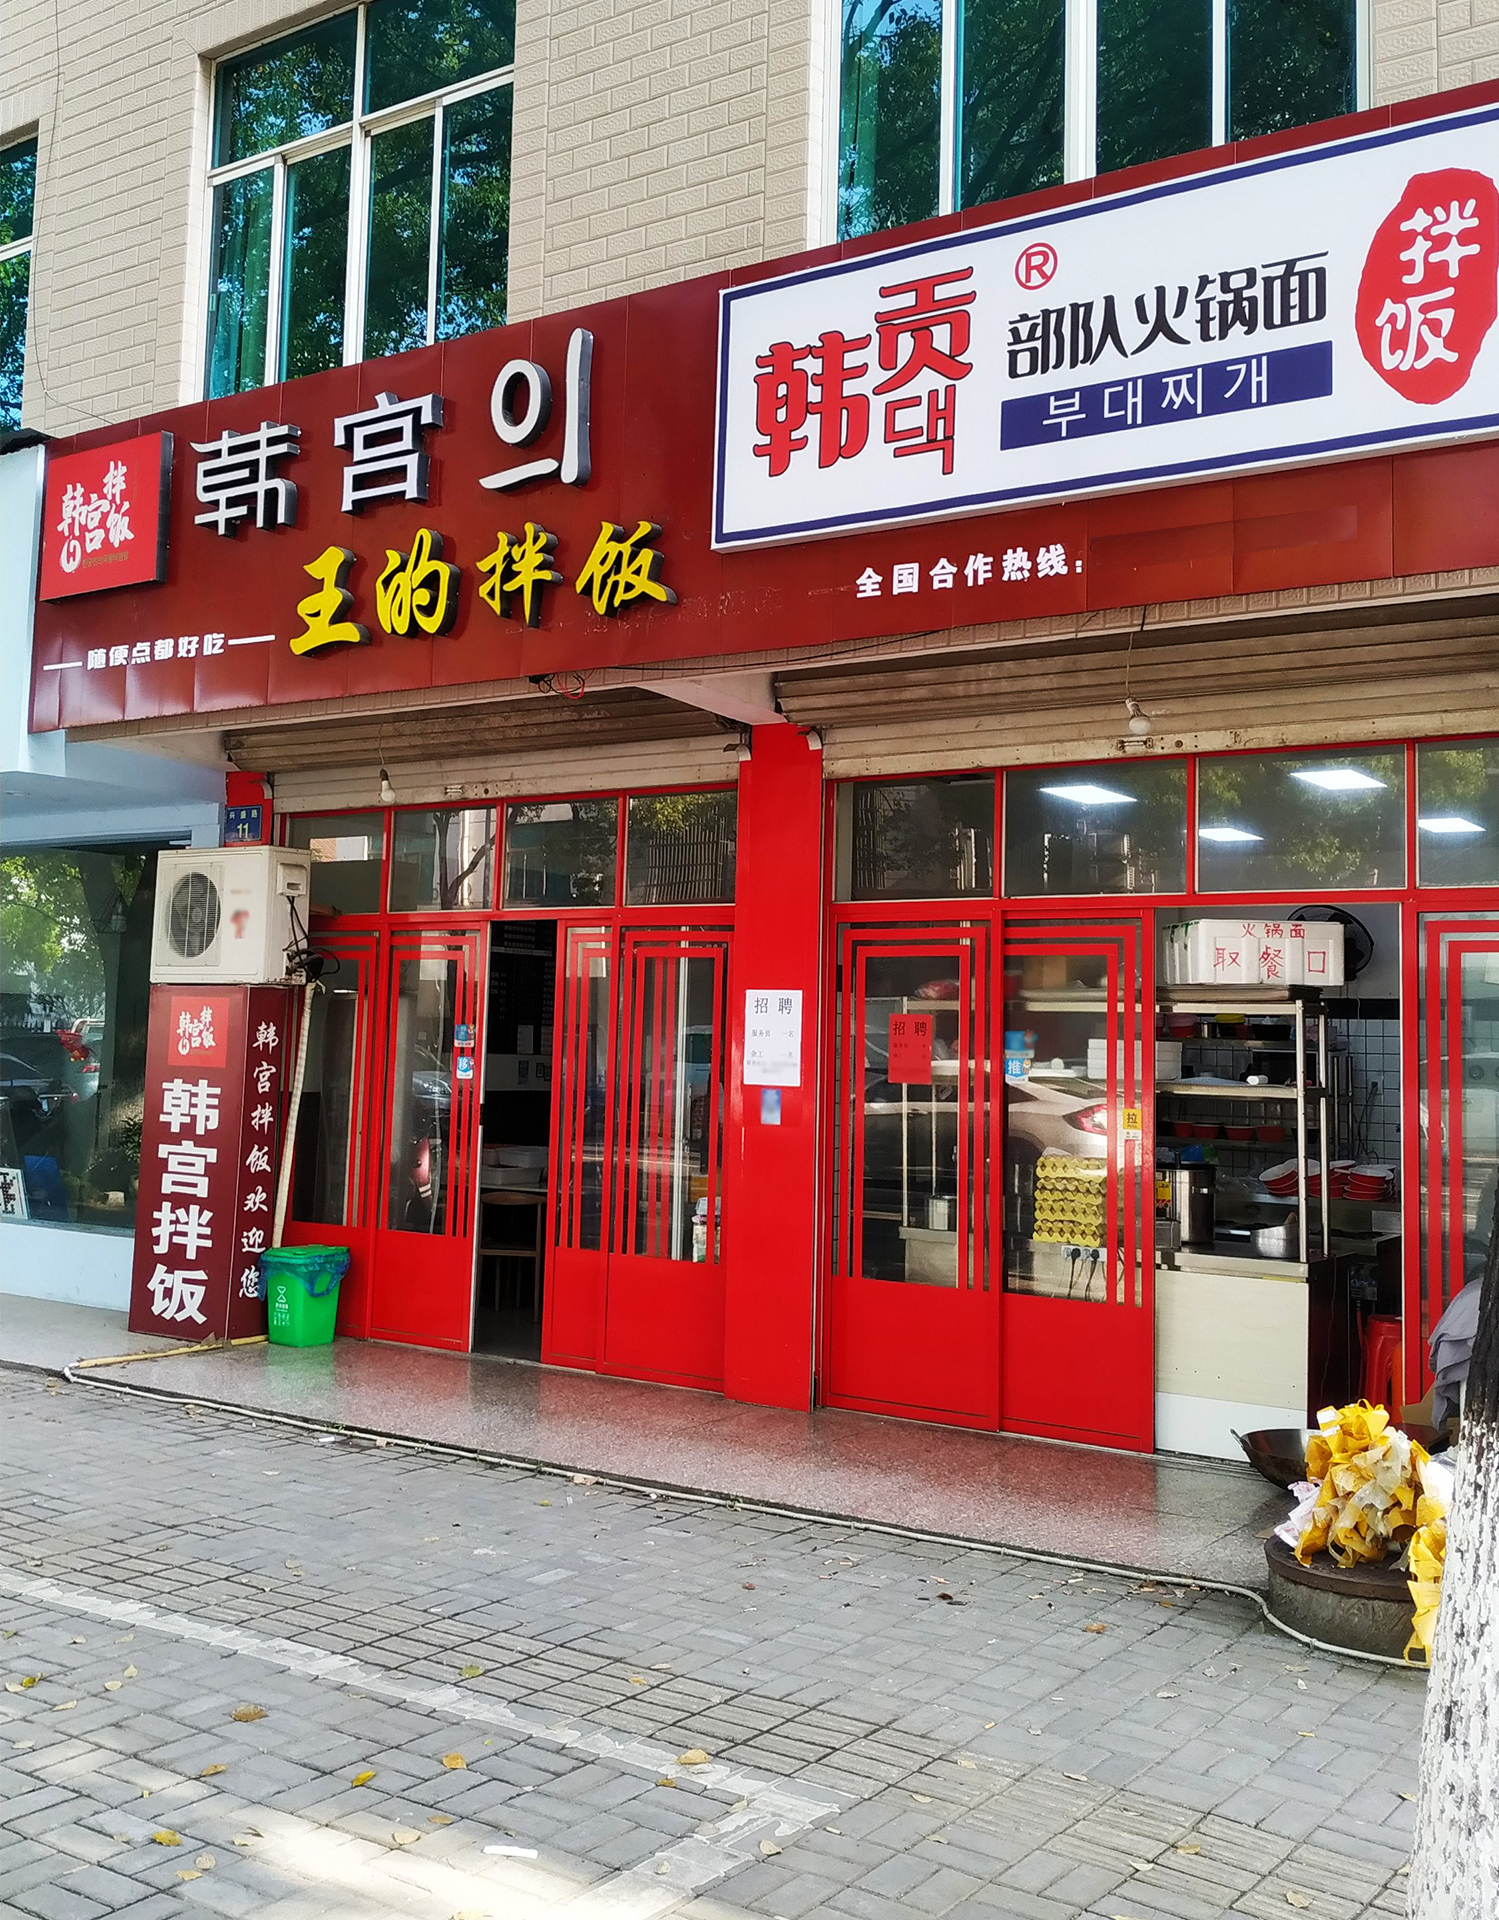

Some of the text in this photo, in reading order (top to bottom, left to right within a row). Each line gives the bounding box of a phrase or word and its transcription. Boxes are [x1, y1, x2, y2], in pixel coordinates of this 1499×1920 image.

[1006, 250, 1329, 379] 部队火锅面
[1376, 198, 1482, 374] 拌饭
[1041, 353, 1270, 437] 부대찌개
[289, 519, 672, 658] 王的拌饭
[236, 822, 249, 839] 11
[1241, 923, 1306, 940] 火锅面
[1212, 944, 1327, 980] 取餐口
[753, 996, 793, 1015] 招聘
[892, 1020, 928, 1037] 招聘
[1126, 1112, 1138, 1124] 拉
[238, 1020, 279, 1299] 韩宫拌饭欢迎您
[147, 1078, 222, 1326] 韩宫拌饭
